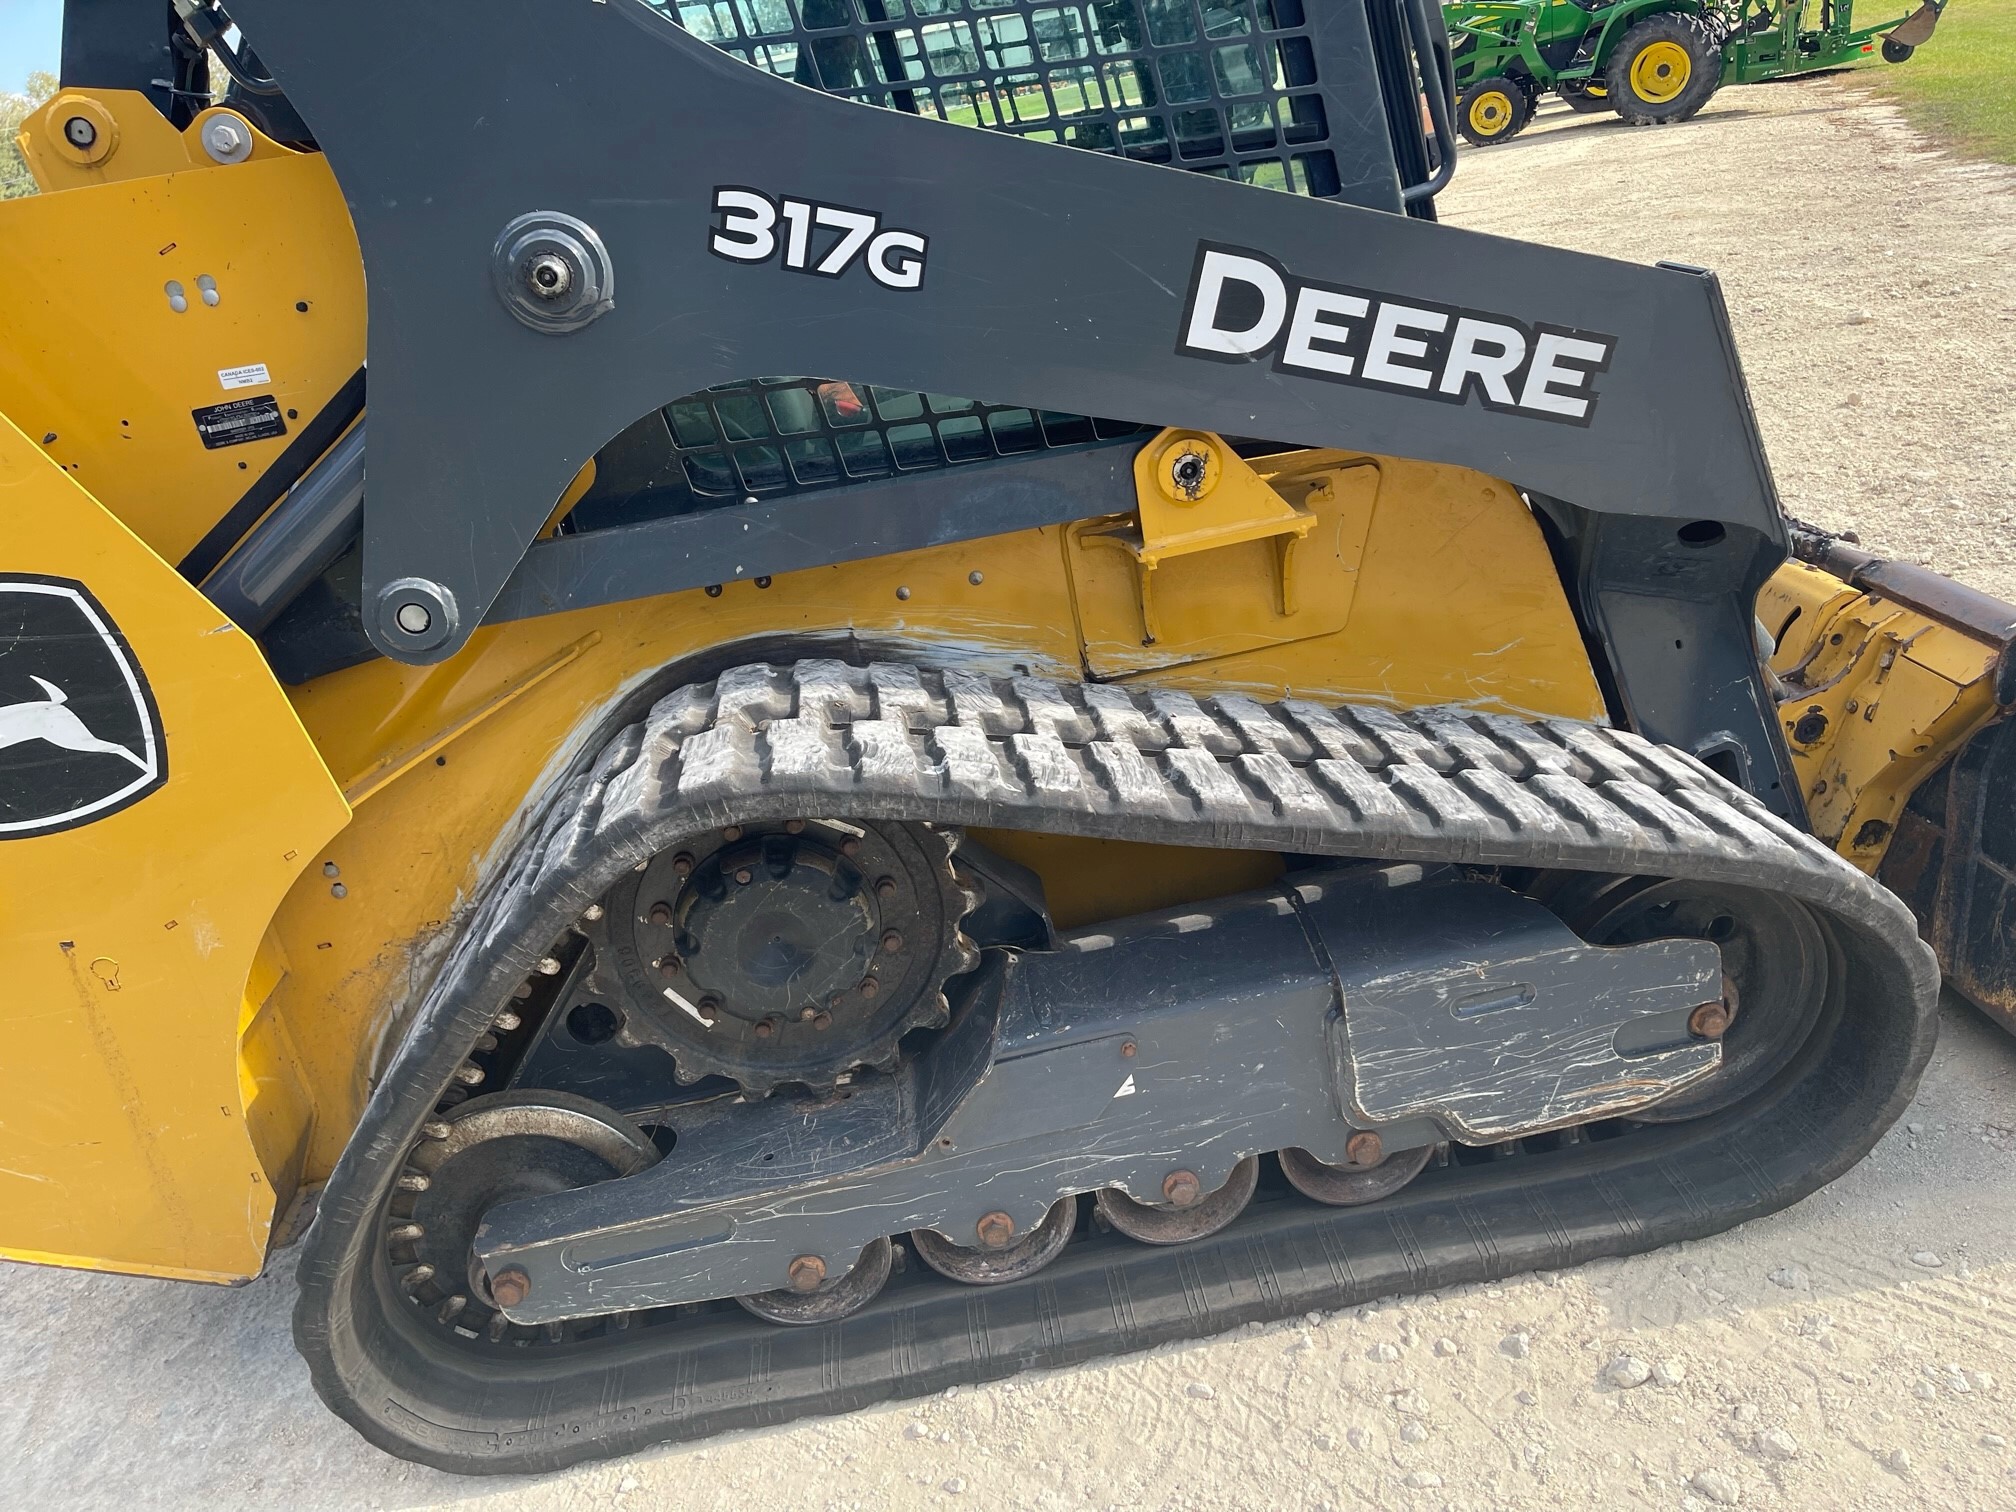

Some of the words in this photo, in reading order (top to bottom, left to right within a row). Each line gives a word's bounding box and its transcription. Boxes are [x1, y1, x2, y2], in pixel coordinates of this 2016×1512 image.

[713, 190, 925, 288] 317G
[1185, 250, 1607, 418] DEERE
[214, 404, 232, 413] JOHN
[233, 399, 254, 408] DEERE
